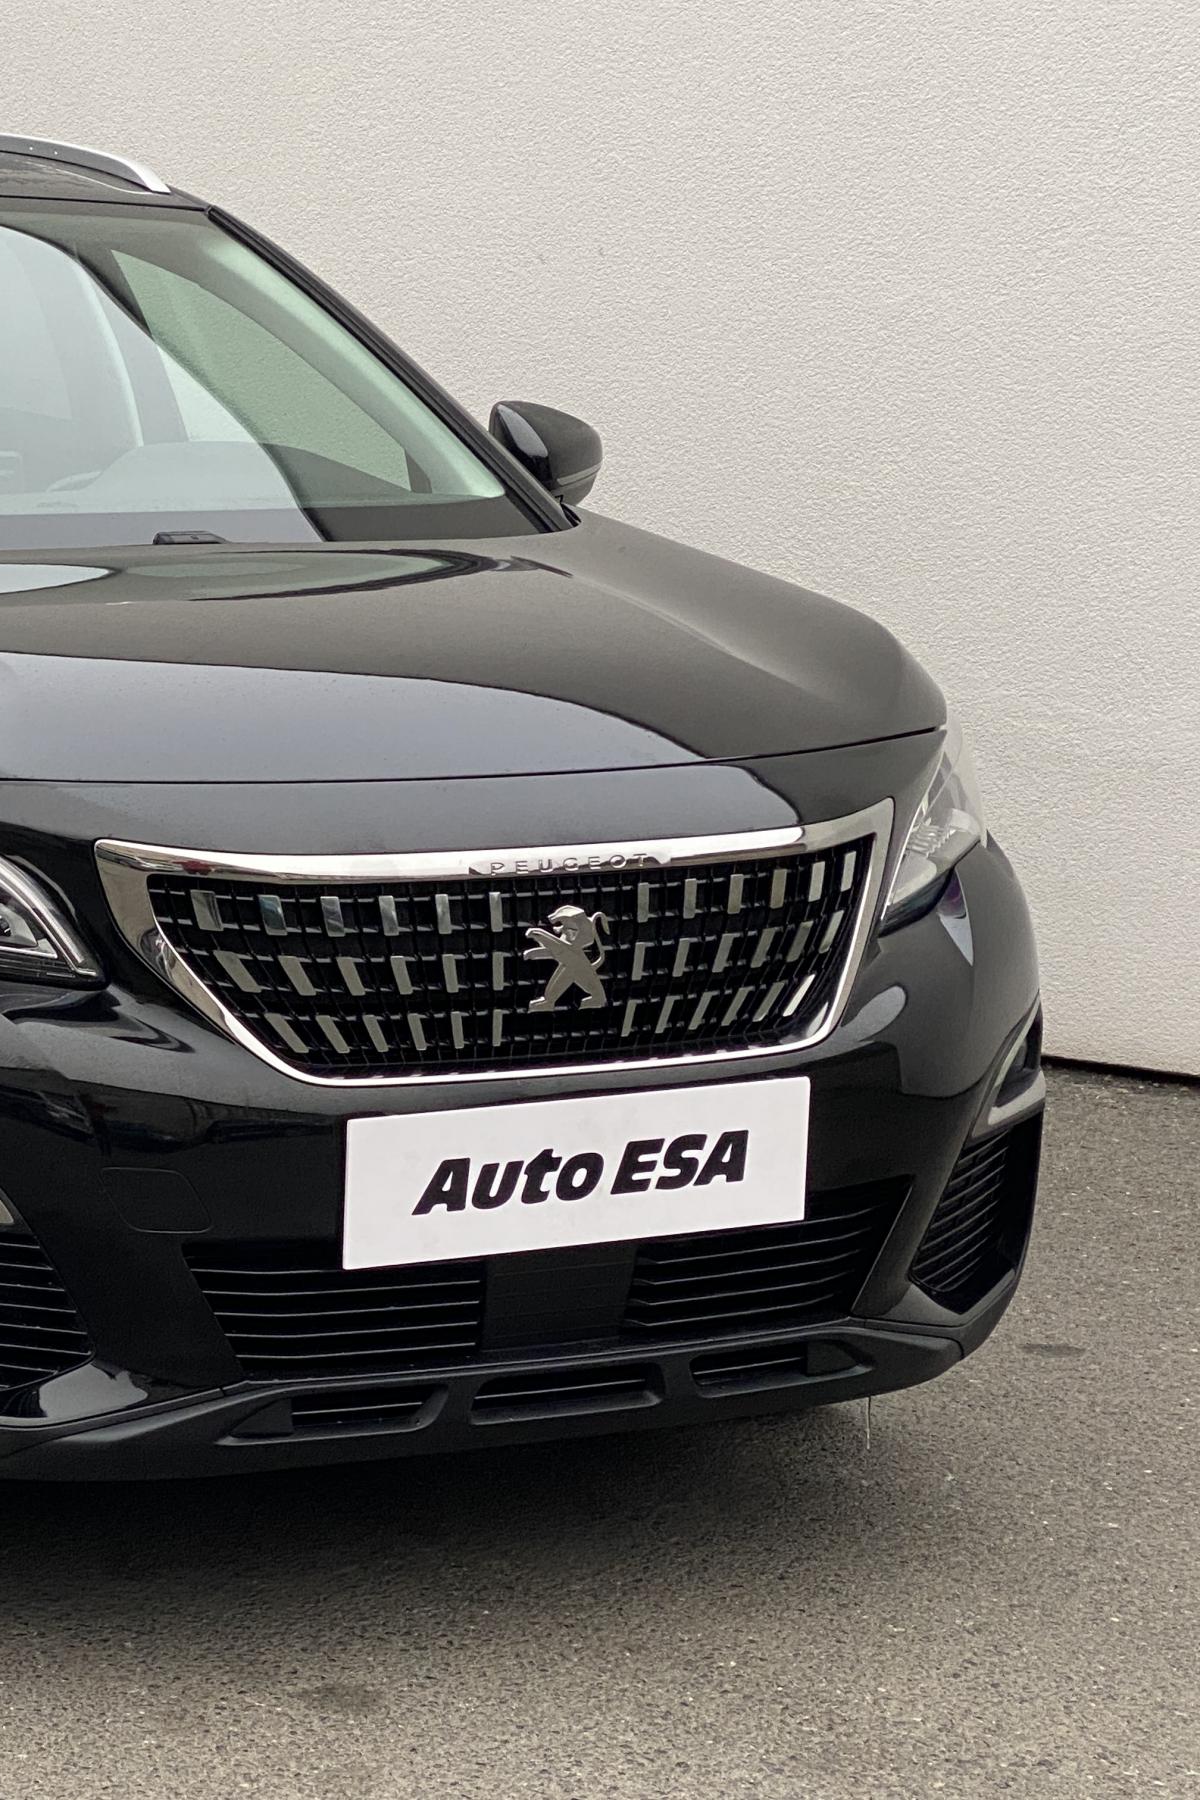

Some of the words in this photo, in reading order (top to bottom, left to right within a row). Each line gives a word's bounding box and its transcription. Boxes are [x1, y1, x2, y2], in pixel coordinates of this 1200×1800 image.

[490, 853, 648, 876] PEUGEOT
[411, 1148, 605, 1216] Auto
[610, 1129, 749, 1195] ESA
